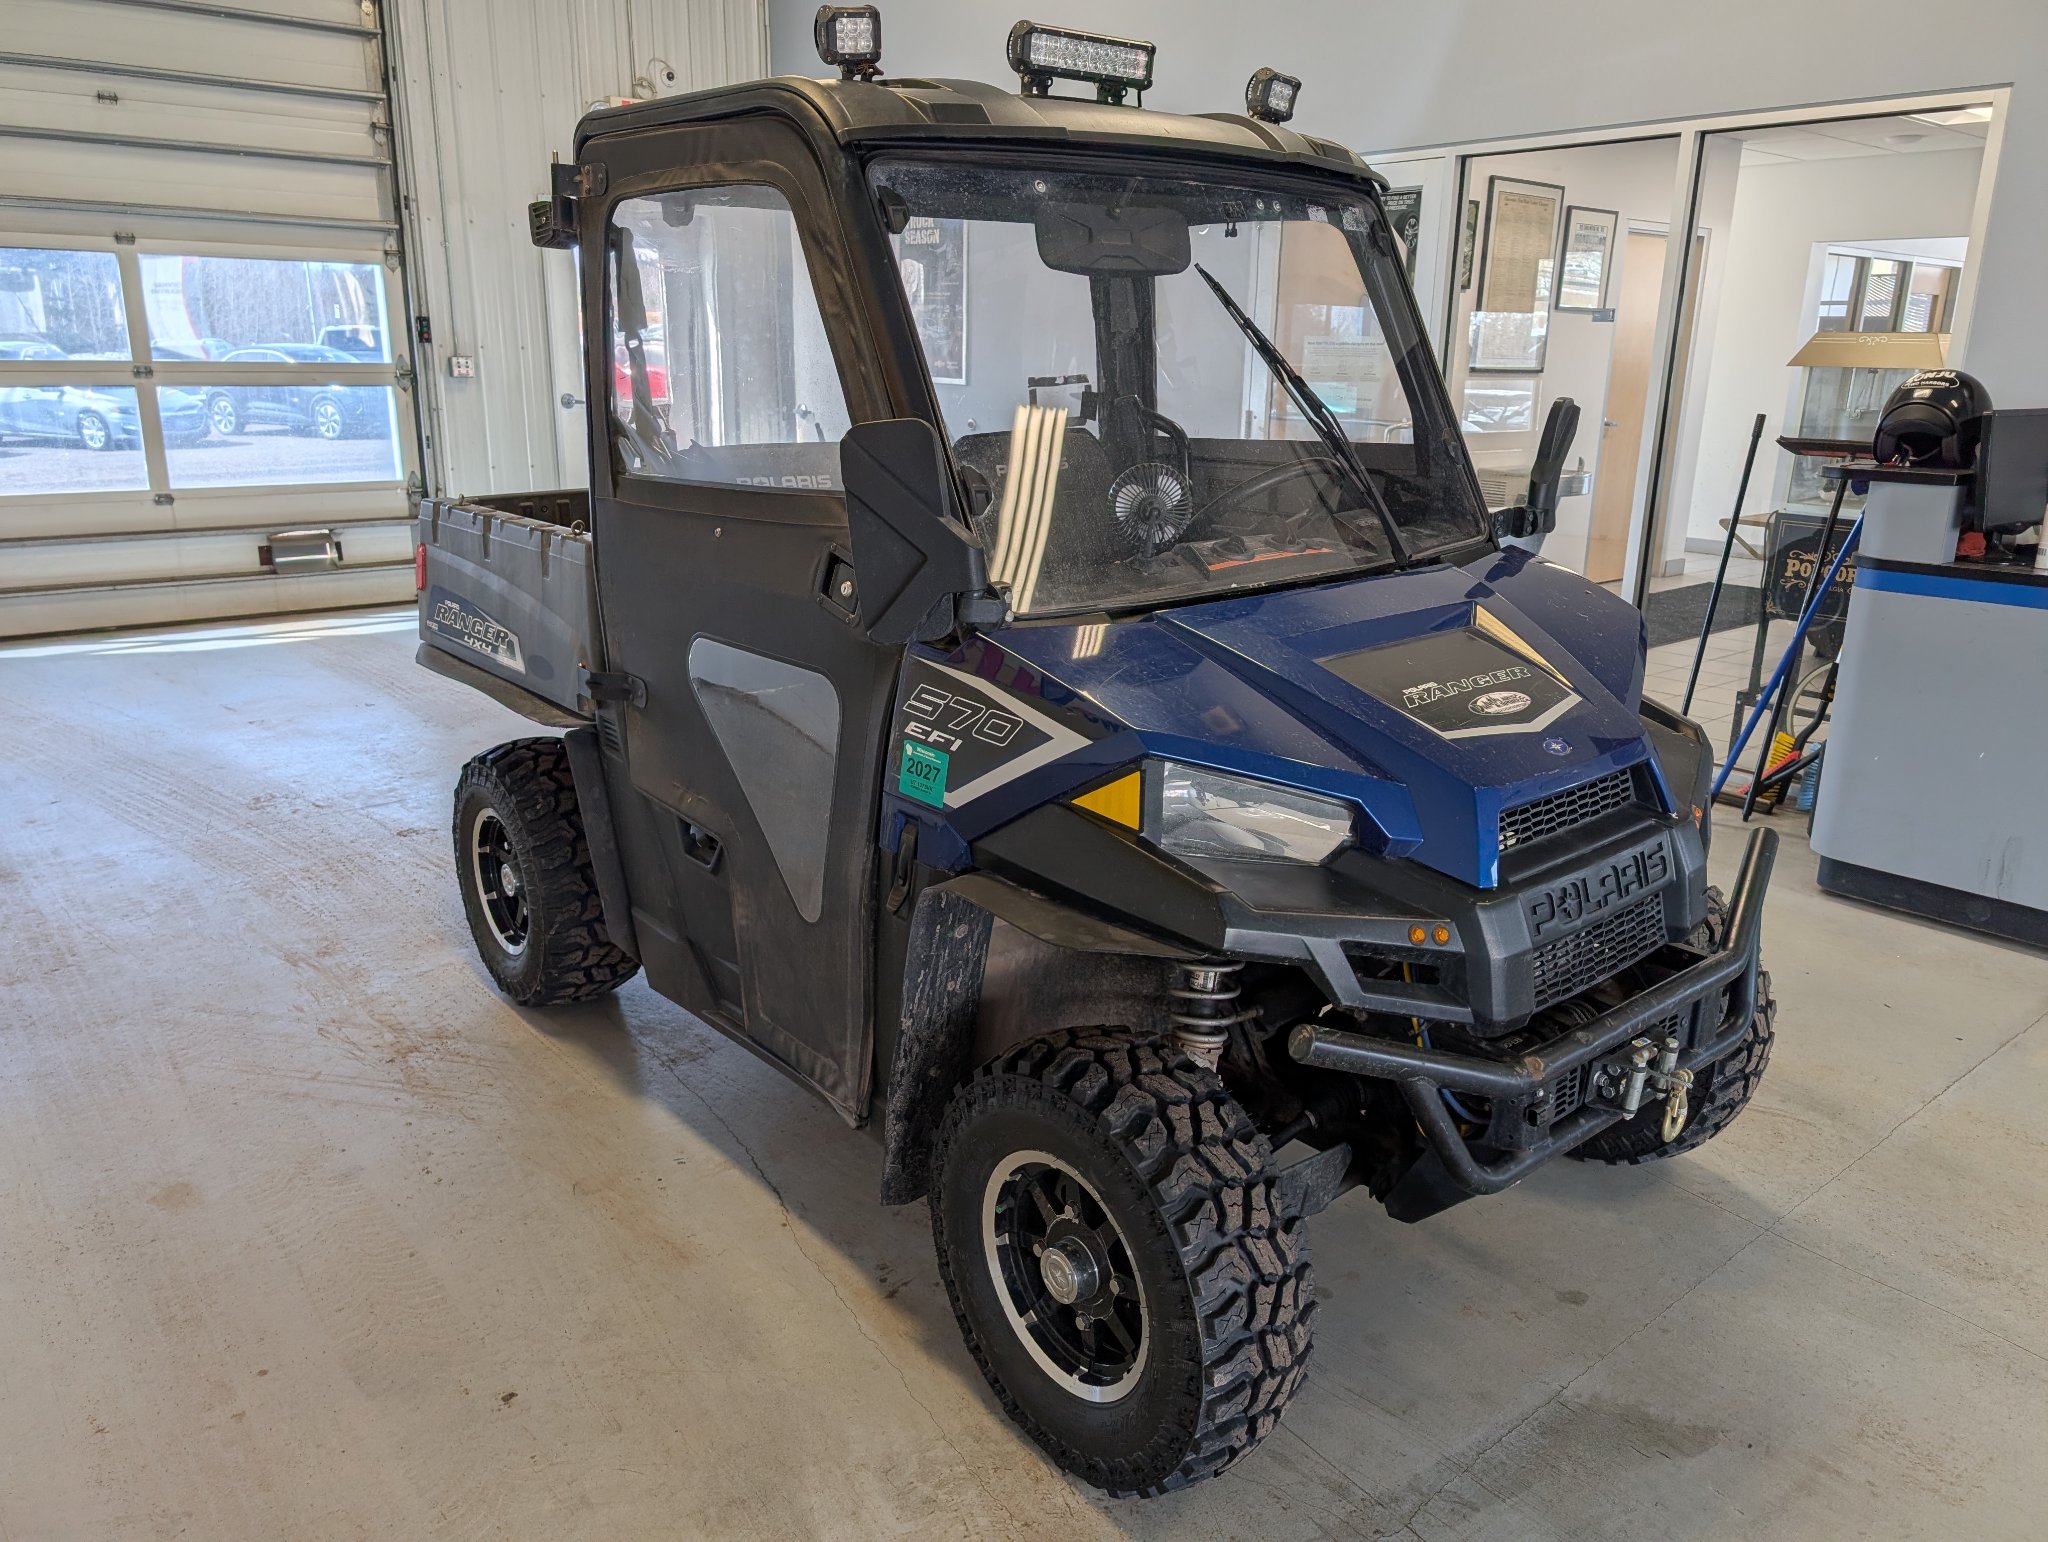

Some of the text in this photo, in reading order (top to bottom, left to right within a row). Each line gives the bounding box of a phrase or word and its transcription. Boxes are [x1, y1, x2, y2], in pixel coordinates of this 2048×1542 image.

[904, 228, 940, 245] SEASON
[736, 474, 832, 488] POLARIS
[1785, 558, 1857, 583] POCOR
[434, 603, 510, 649] RANGER
[1404, 666, 1531, 708] RANGER
[903, 683, 1024, 747] 570
[904, 721, 963, 752] EFI
[906, 757, 942, 783] 2027
[1530, 840, 1668, 937] POLARIS
